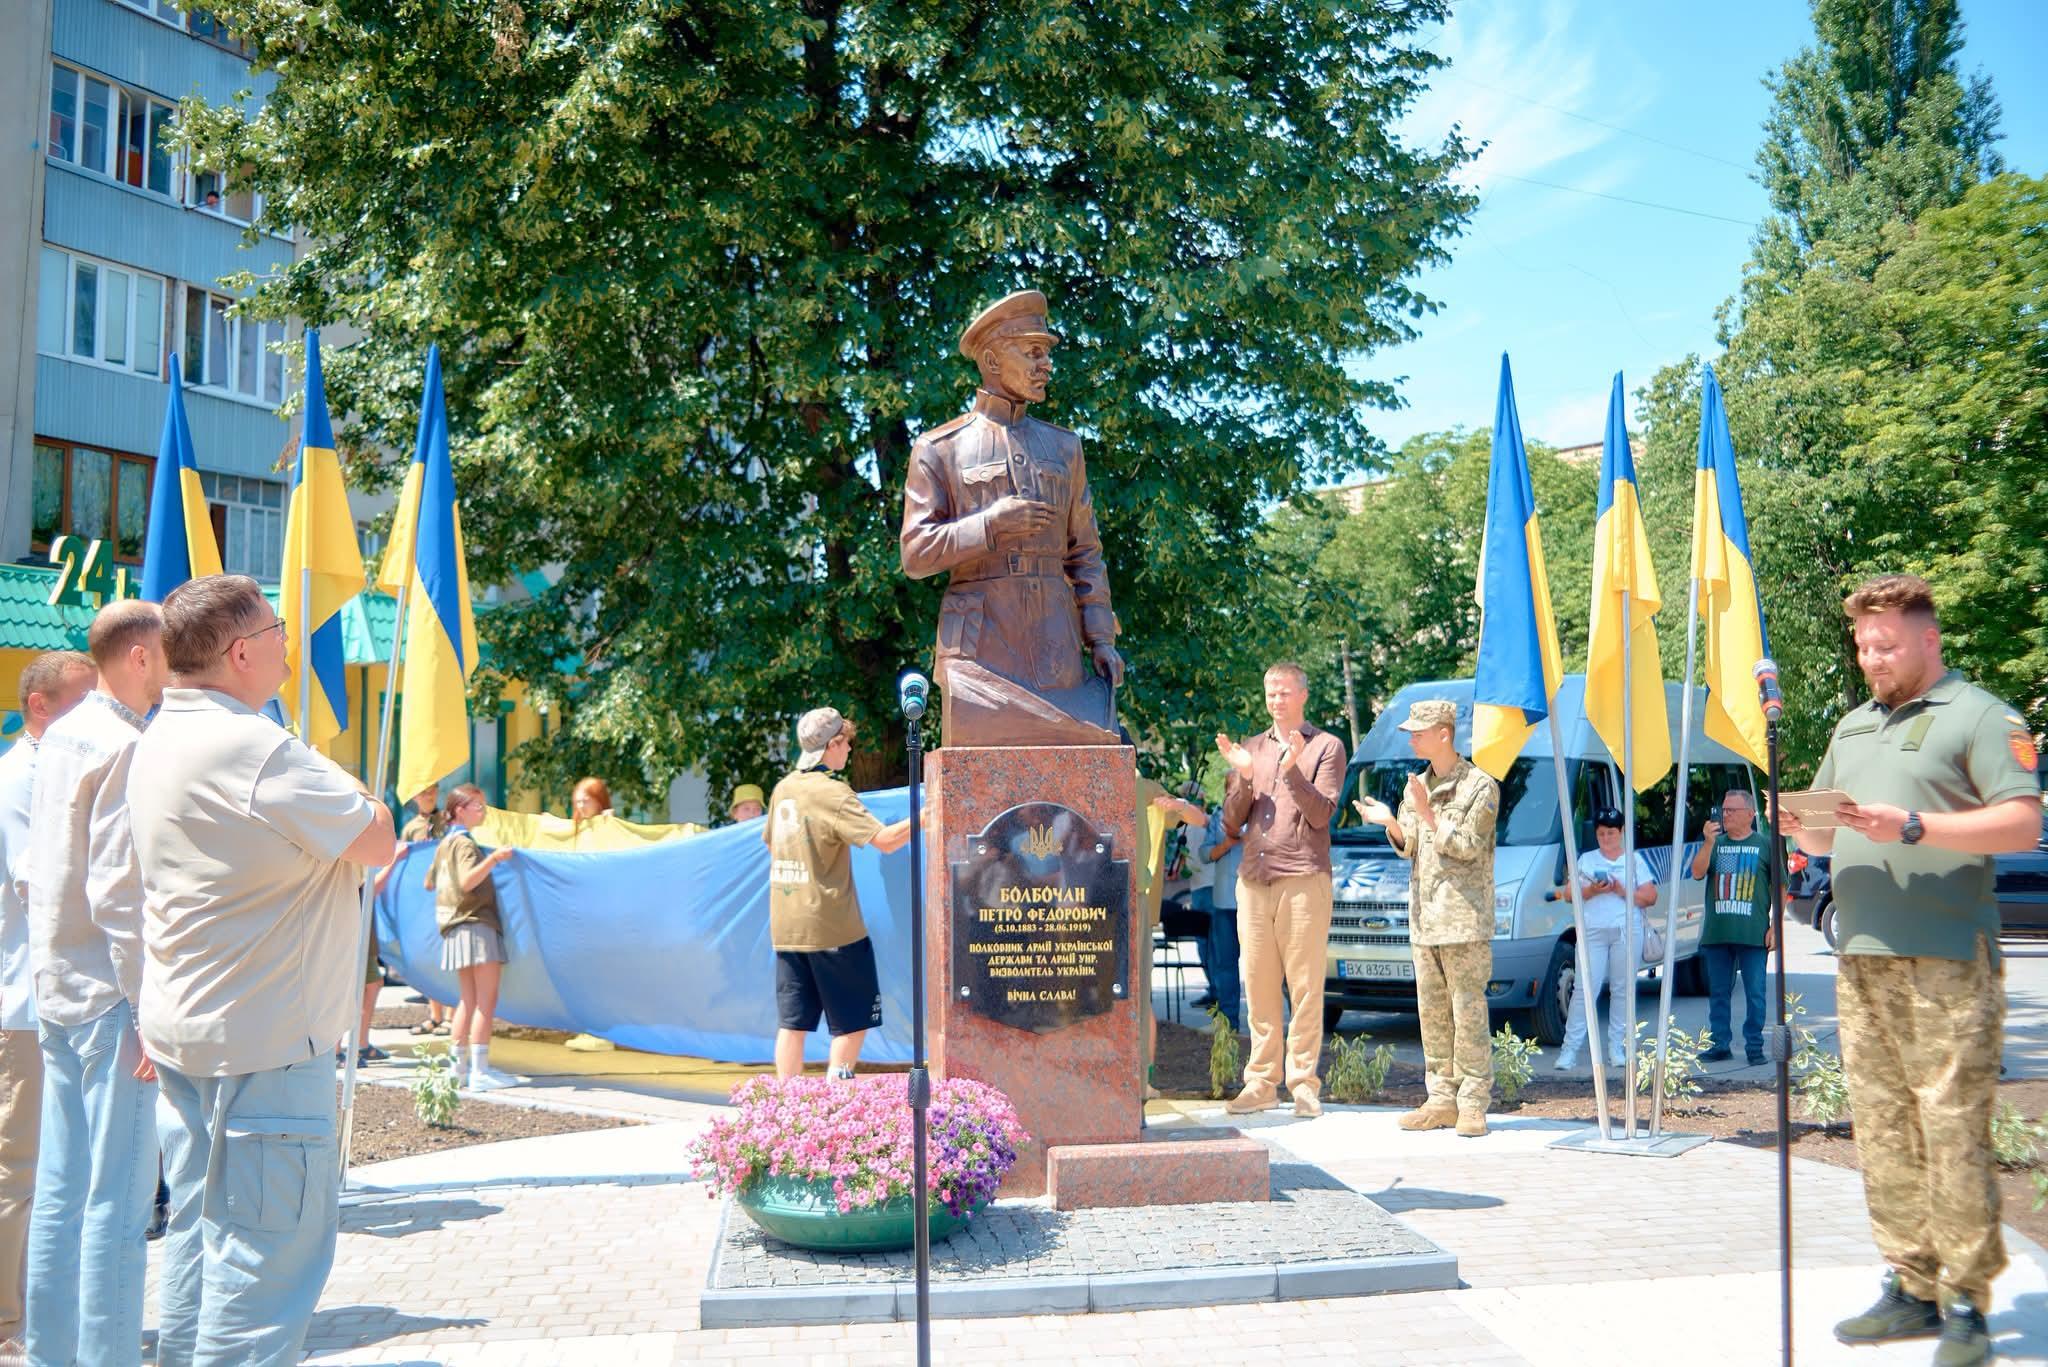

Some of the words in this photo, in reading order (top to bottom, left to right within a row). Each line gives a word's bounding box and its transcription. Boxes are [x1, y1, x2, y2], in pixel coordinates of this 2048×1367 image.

[1720, 845, 1741, 854] STAND
[1741, 845, 1760, 856] WITH
[1000, 886, 1085, 903] БОЛБОЧАН
[979, 907, 1022, 921] ПЕТРО
[1027, 907, 1106, 921] ФЕДОРОВИЧ
[1715, 900, 1752, 916] UKRAINE
[994, 923, 1037, 934] (5.10.1883
[1044, 923, 1091, 933] 28.06.1919)
[969, 942, 1023, 953] ПОЛКОВНИК
[1026, 941, 1052, 952] АРМІЇ
[1055, 940, 1113, 952] УКРАЇНСЬКОЇ
[988, 954, 1033, 966] ДЕРЖАВИ
[1035, 954, 1048, 965] ТА
[1050, 953, 1076, 964] АРМІЇ
[1079, 954, 1099, 964] УНР.
[990, 966, 1054, 977] ВИЗВОЛИТЕЛЬ
[1056, 964, 1097, 976] УКРАЇНИ.
[1366, 964, 1392, 976] 8325
[1007, 988, 1036, 1001] ВІЧНА
[1039, 989, 1076, 1001] СЛАВА!
